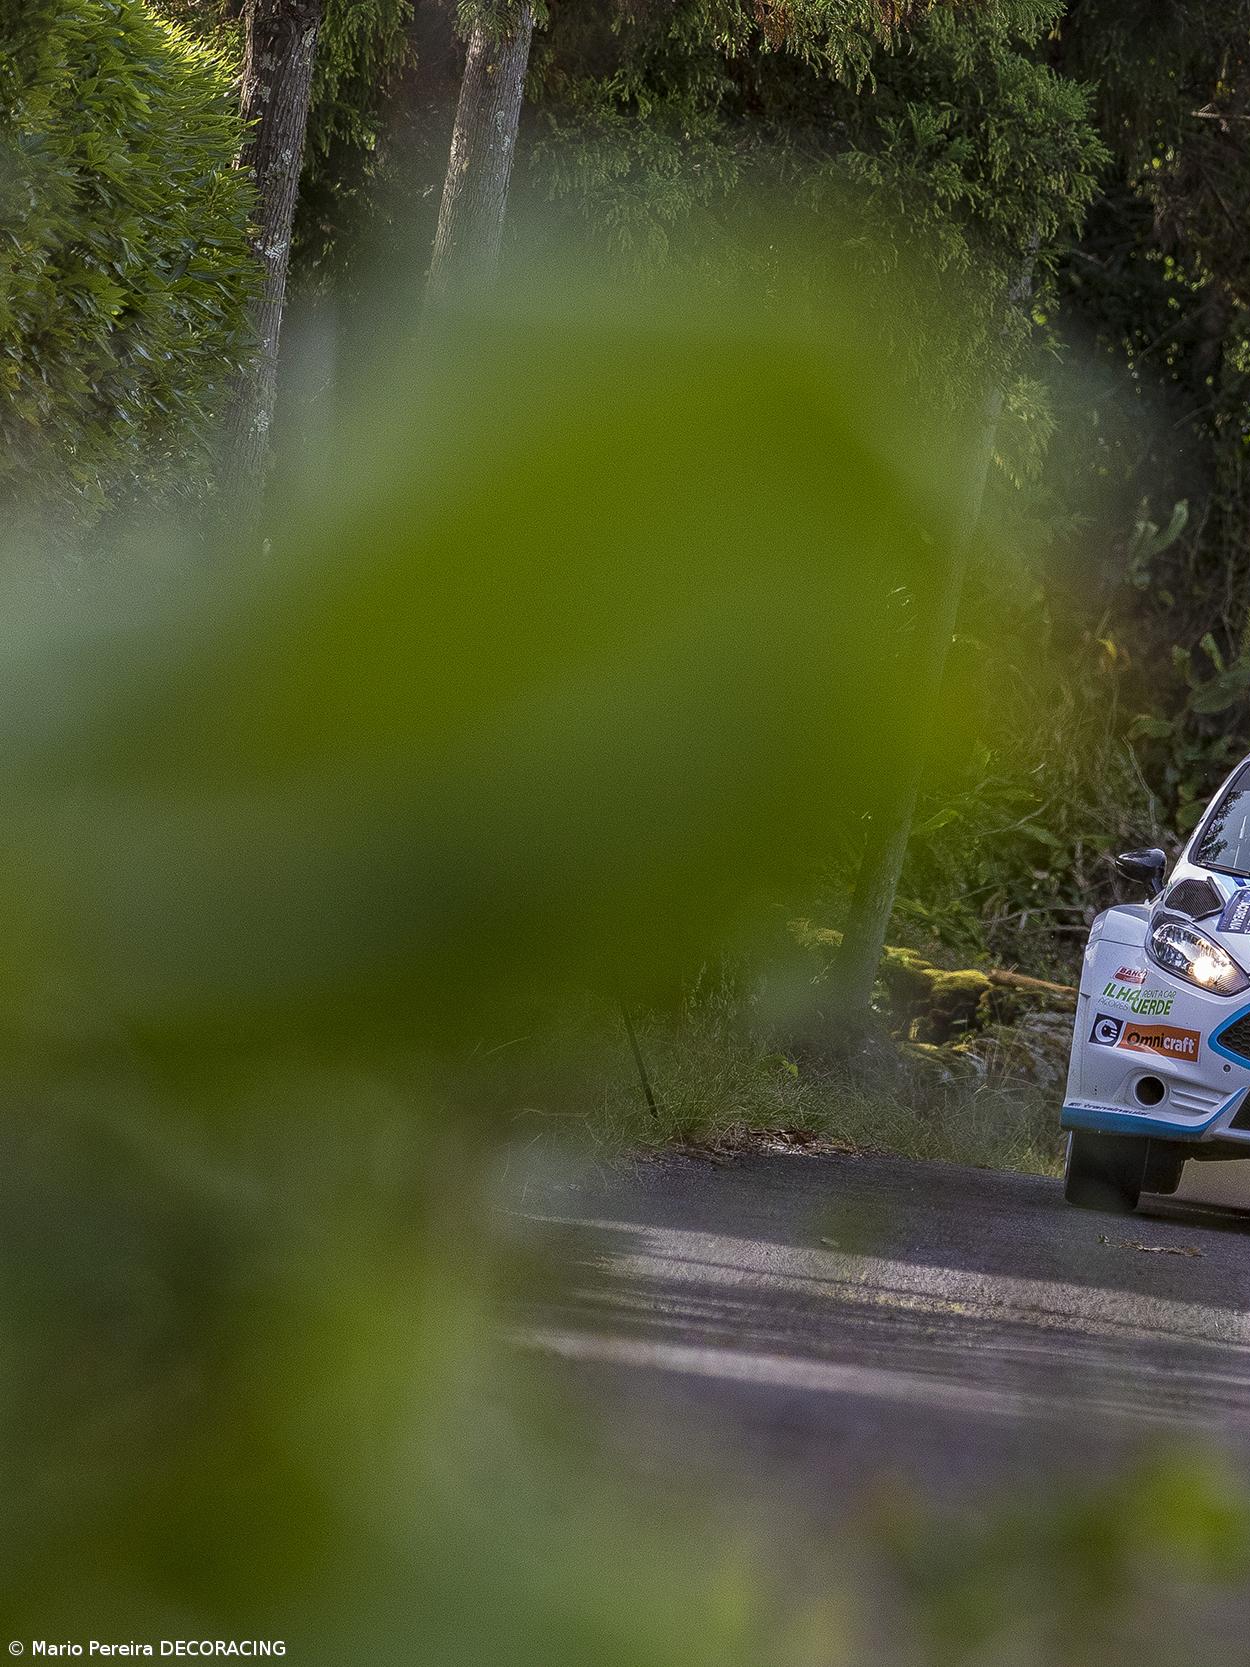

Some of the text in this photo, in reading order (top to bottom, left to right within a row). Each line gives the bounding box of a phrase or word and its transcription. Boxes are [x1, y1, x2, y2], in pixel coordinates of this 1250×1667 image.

[1102, 982, 1141, 1002] ILHA
[1131, 1000, 1174, 1015] VERDE
[1127, 1032, 1195, 1054] Omnicraft
